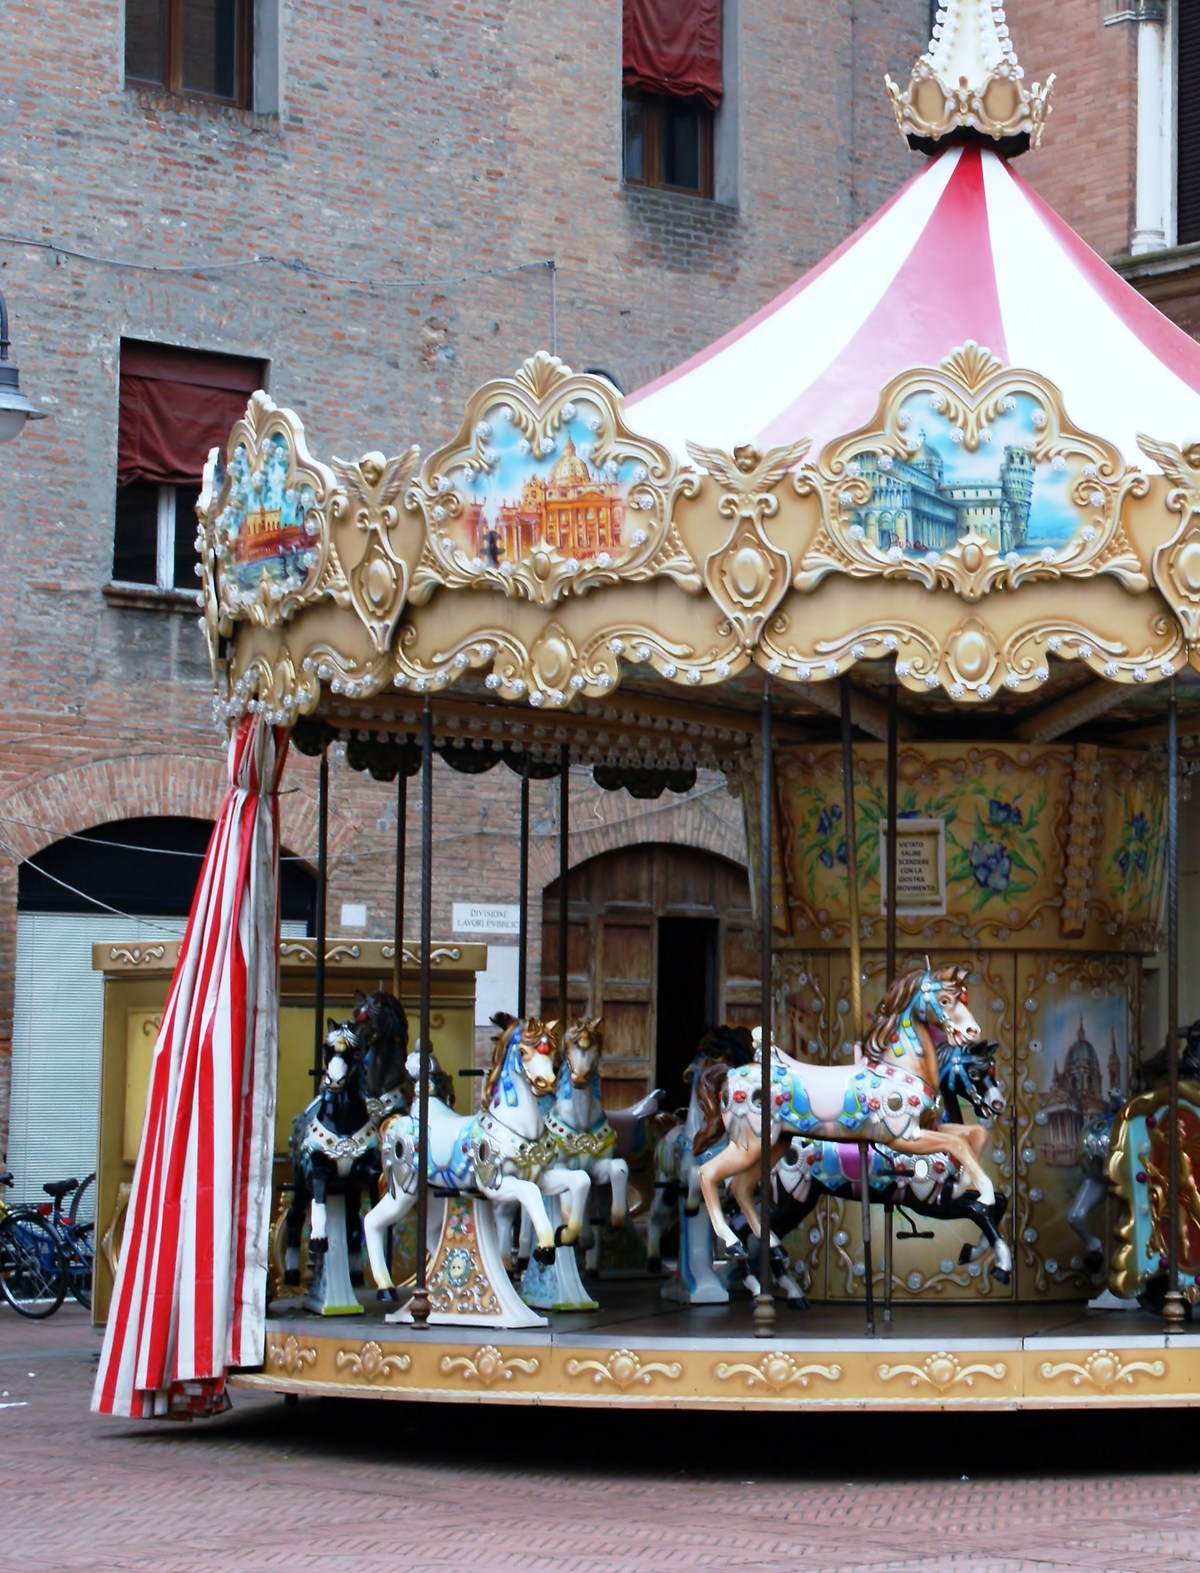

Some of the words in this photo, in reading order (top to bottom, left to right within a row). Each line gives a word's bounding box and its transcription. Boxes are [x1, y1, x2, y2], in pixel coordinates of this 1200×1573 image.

[470, 909, 507, 918] DIVISIONE
[457, 919, 484, 928] LAVORI
[486, 920, 518, 929] PVBBLIC
